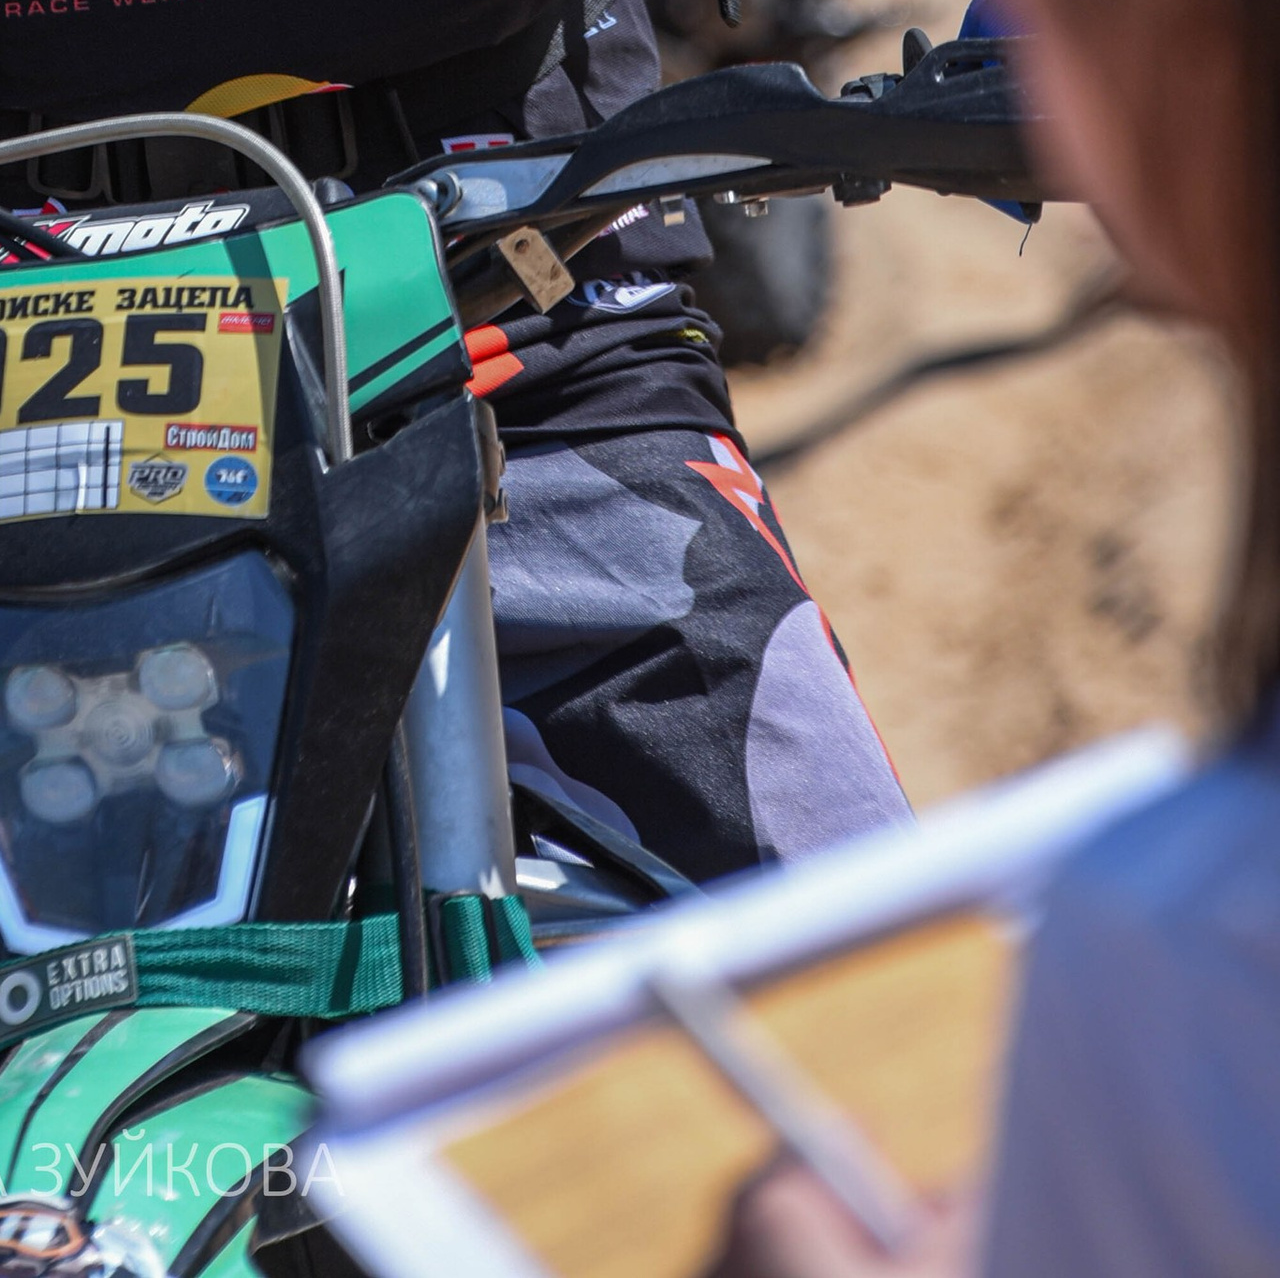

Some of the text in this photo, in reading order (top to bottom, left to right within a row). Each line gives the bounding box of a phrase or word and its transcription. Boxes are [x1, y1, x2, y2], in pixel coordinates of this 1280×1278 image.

[115, 285, 255, 313] ЗАЦЕПА
[166, 424, 256, 452] СтройДом
[46, 943, 128, 987] EXTRA
[48, 968, 130, 1011] OPTIONS
